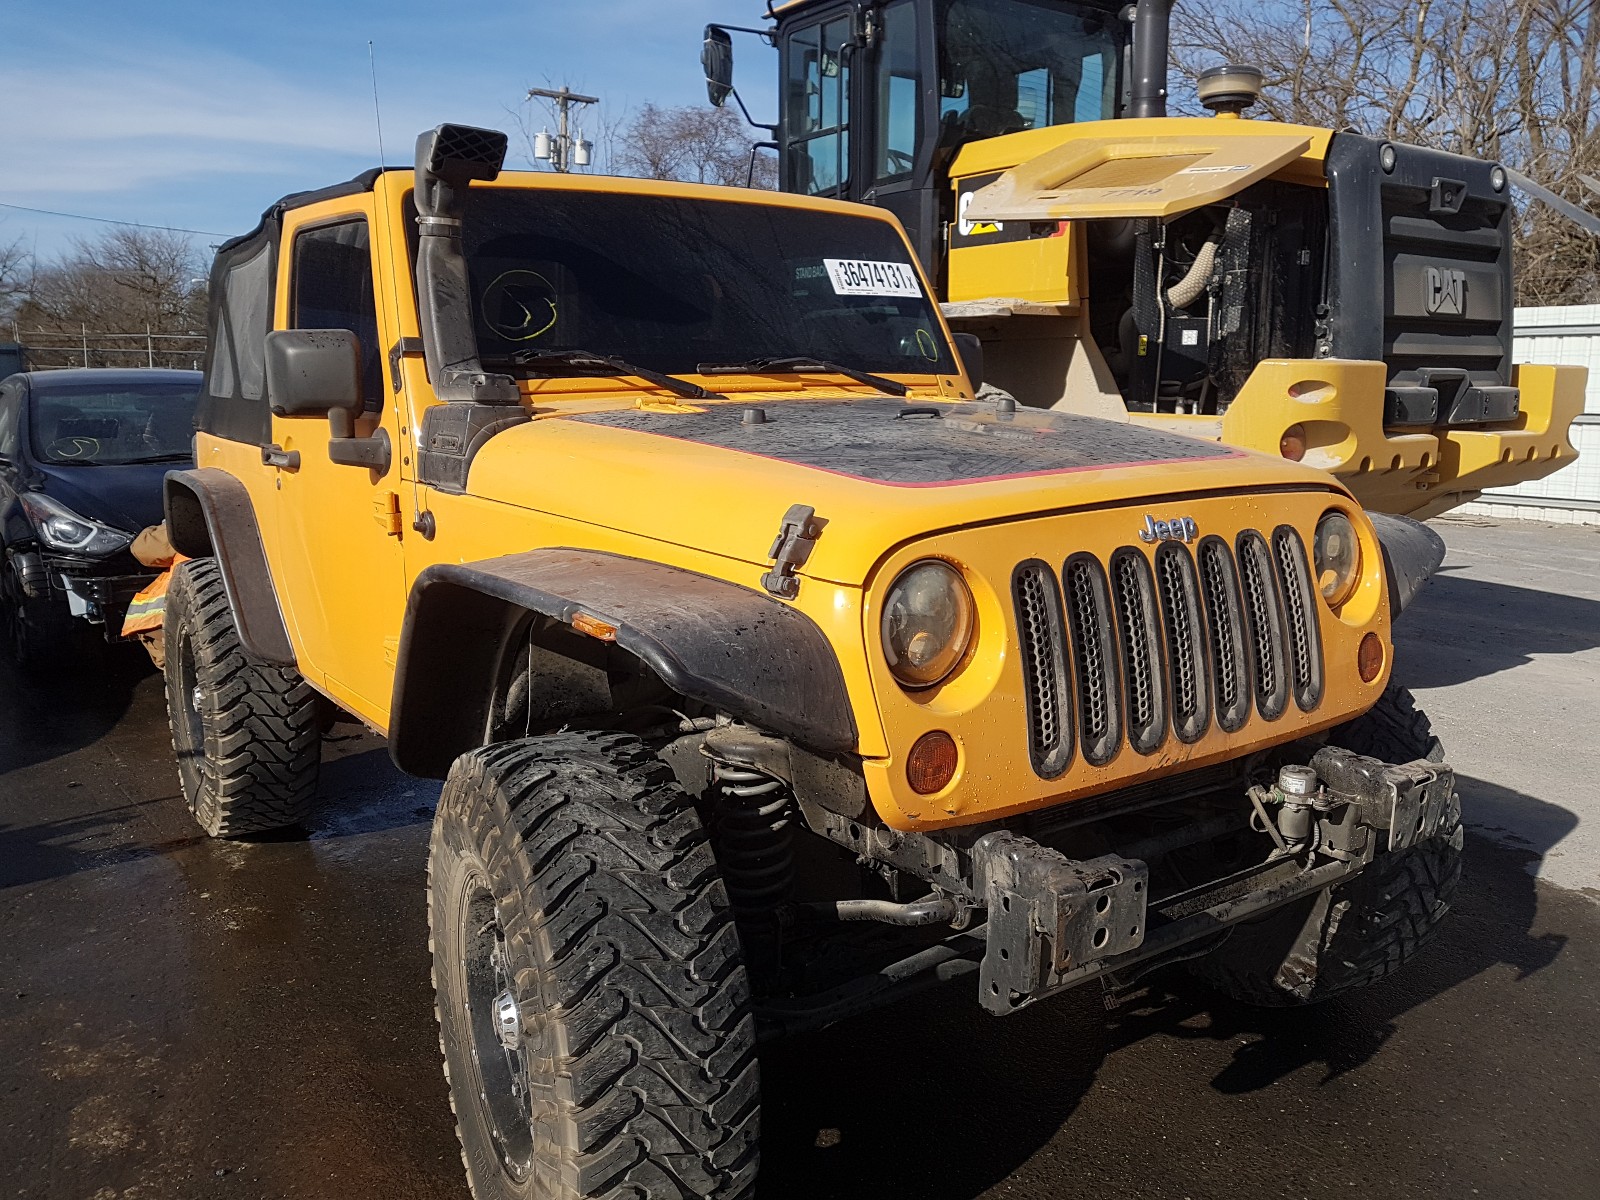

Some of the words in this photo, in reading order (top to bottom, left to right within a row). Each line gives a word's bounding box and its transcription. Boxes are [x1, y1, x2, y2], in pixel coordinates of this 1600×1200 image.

[839, 261, 907, 289] 36474131
[1426, 267, 1466, 315] CAT
[1139, 514, 1196, 543] Jeep
